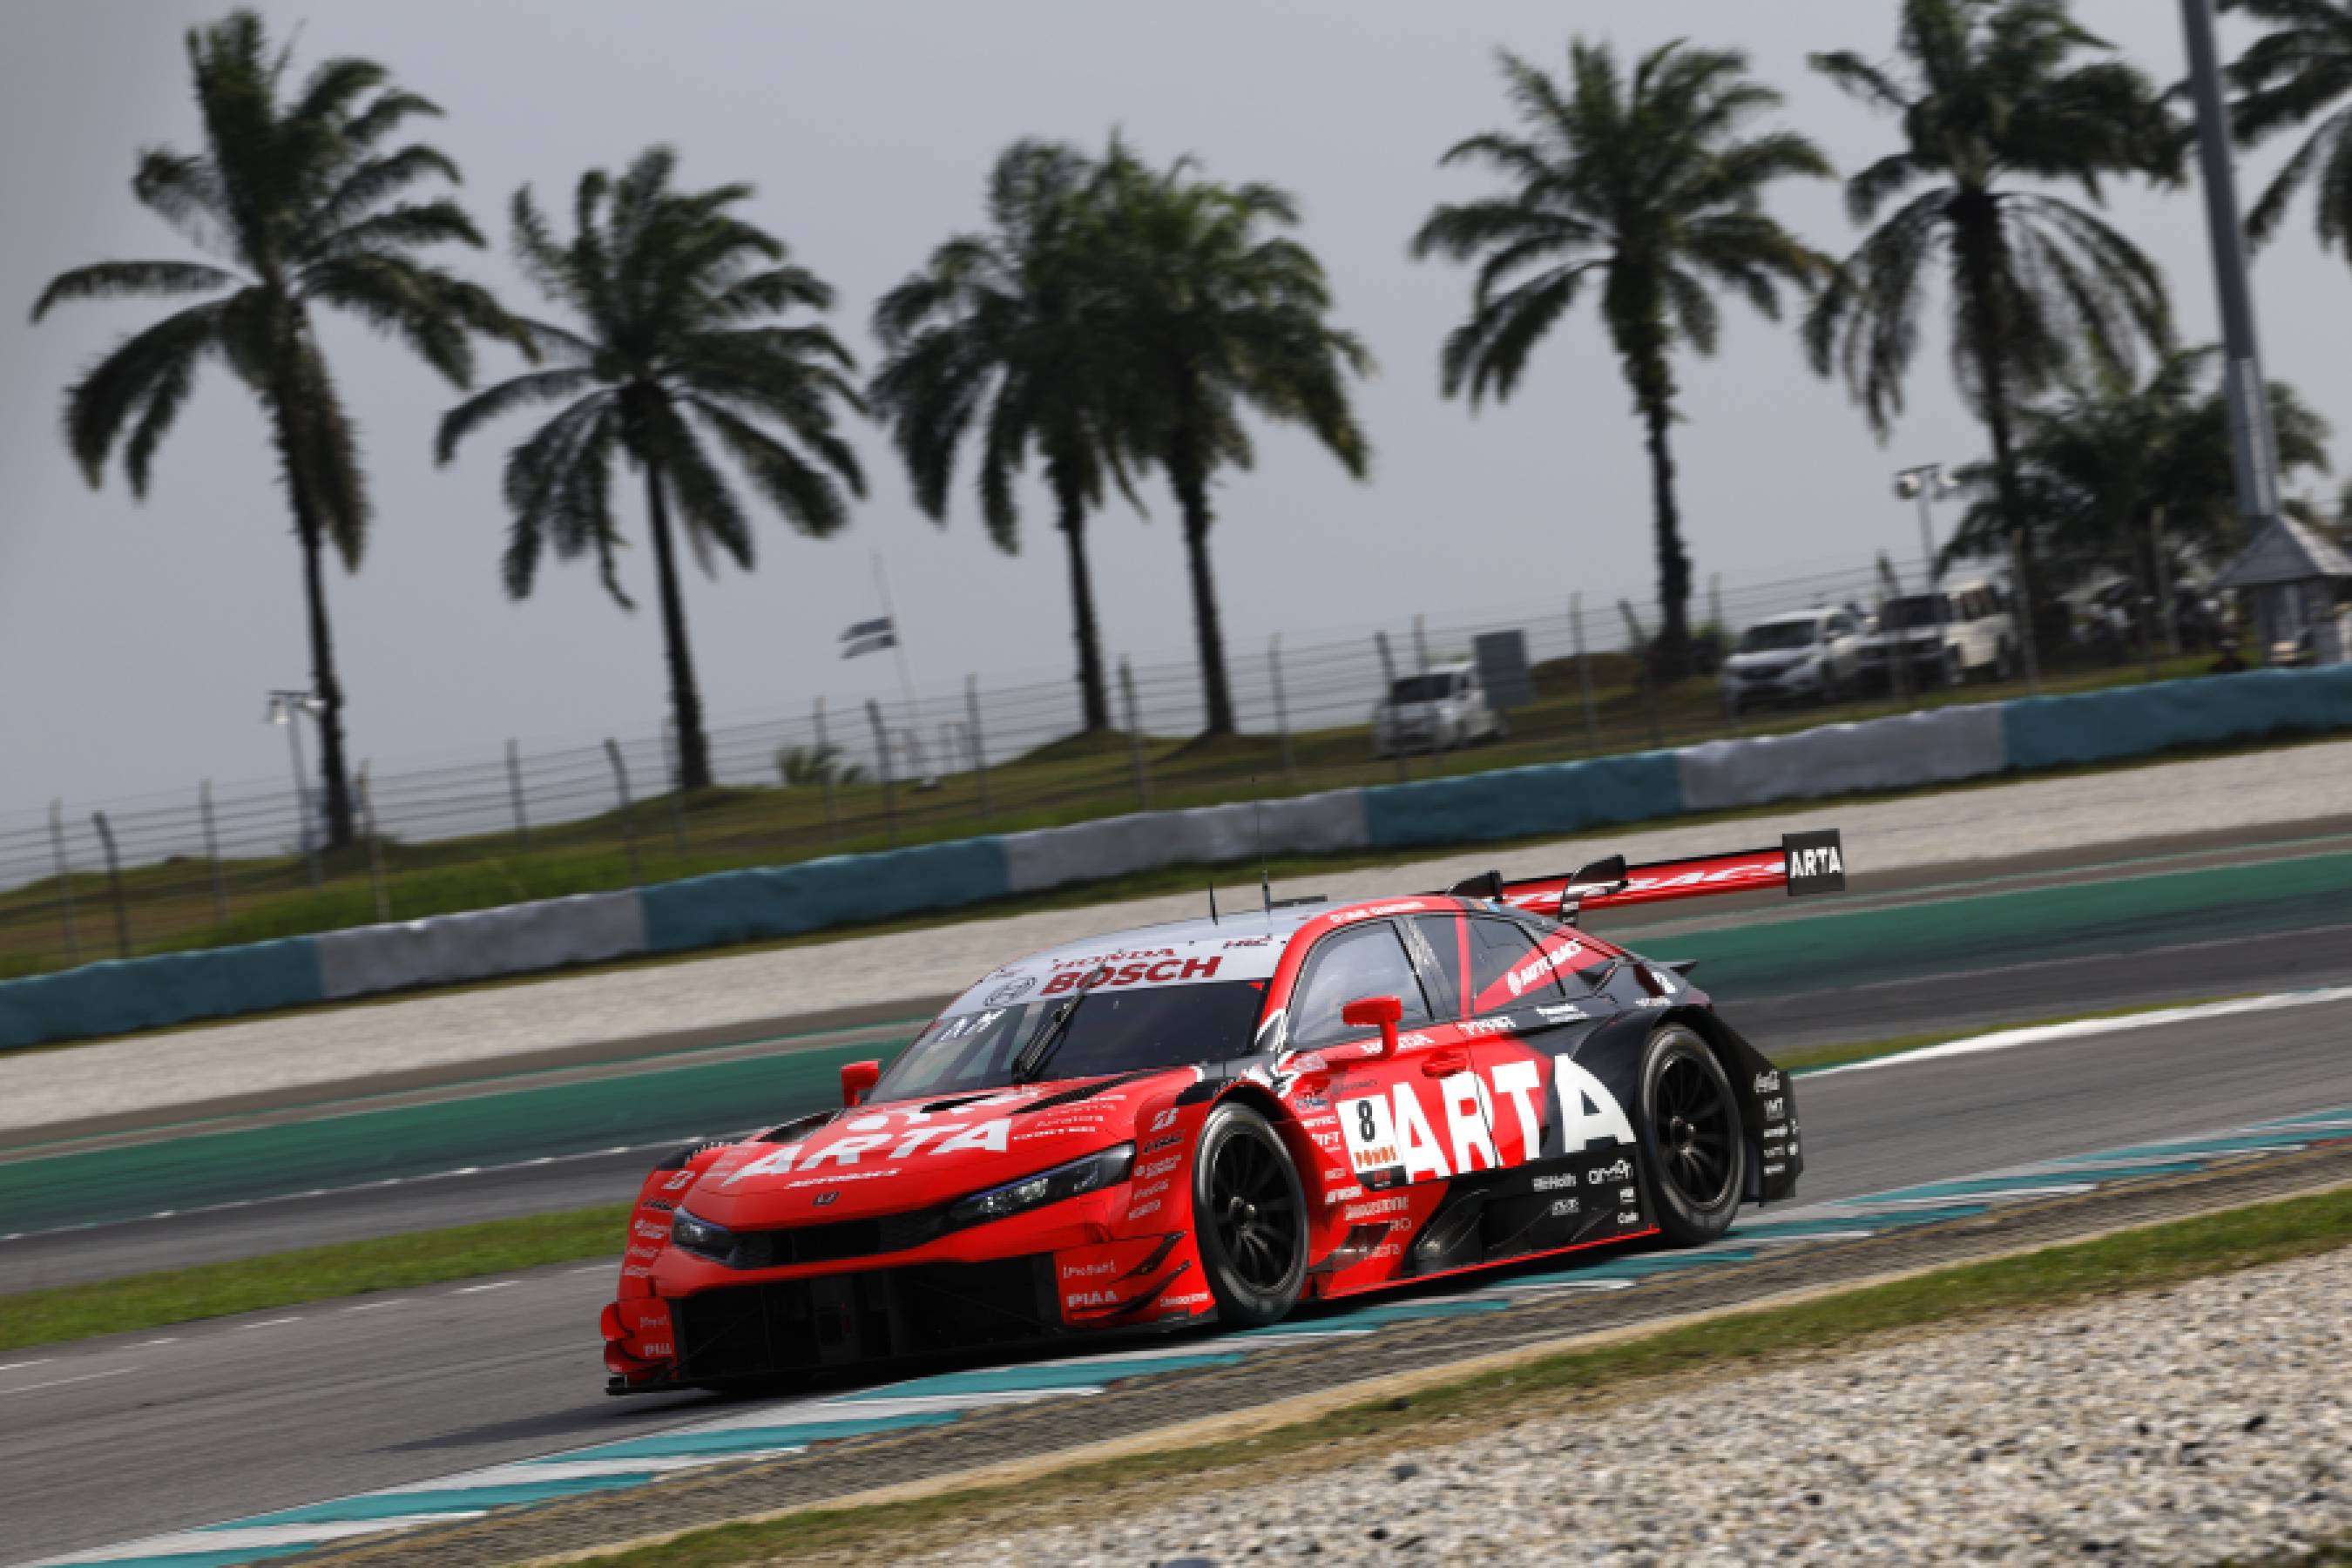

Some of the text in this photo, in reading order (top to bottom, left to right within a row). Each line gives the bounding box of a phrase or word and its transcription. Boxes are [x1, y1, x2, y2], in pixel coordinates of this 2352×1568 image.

[1791, 846, 1843, 879] ARTA
[1040, 955, 1222, 996] BOSCH
[1355, 1099, 1376, 1143] 8
[1391, 1052, 1638, 1184] ARTA
[720, 1119, 1011, 1187] ARTA
[1067, 1289, 1118, 1308] PIAA
